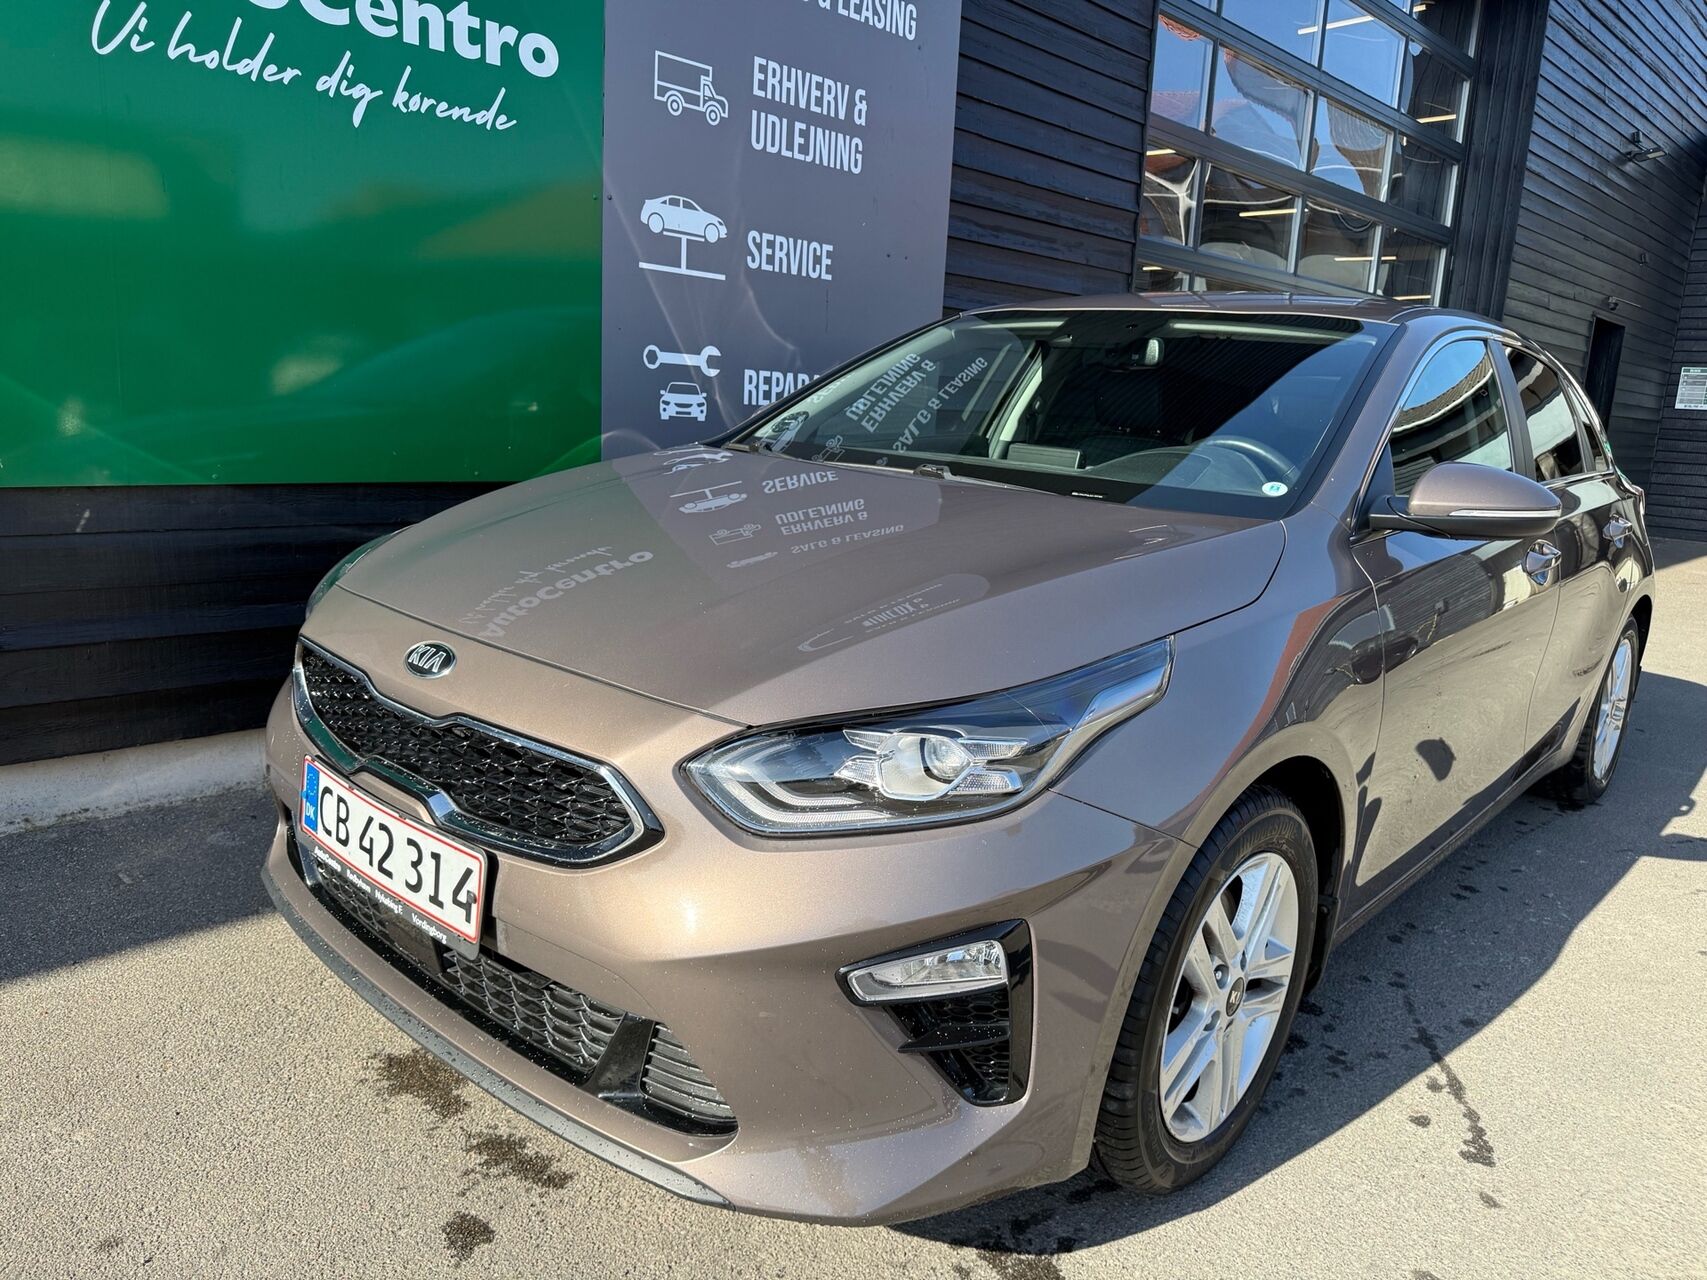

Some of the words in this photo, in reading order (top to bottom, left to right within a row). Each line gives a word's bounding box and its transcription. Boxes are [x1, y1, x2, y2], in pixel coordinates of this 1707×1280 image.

[167, 10, 302, 85] holder
[315, 50, 383, 129] dig
[392, 65, 517, 130] kørende
[752, 55, 850, 121] ERHVERV
[853, 88, 868, 126] &
[751, 109, 864, 175] UDLEJNING
[746, 229, 834, 281] SERVICE
[408, 644, 447, 673] KIA
[305, 802, 316, 820] DK
[319, 785, 350, 847] CB
[358, 815, 394, 880] 42
[405, 837, 477, 924] 314
